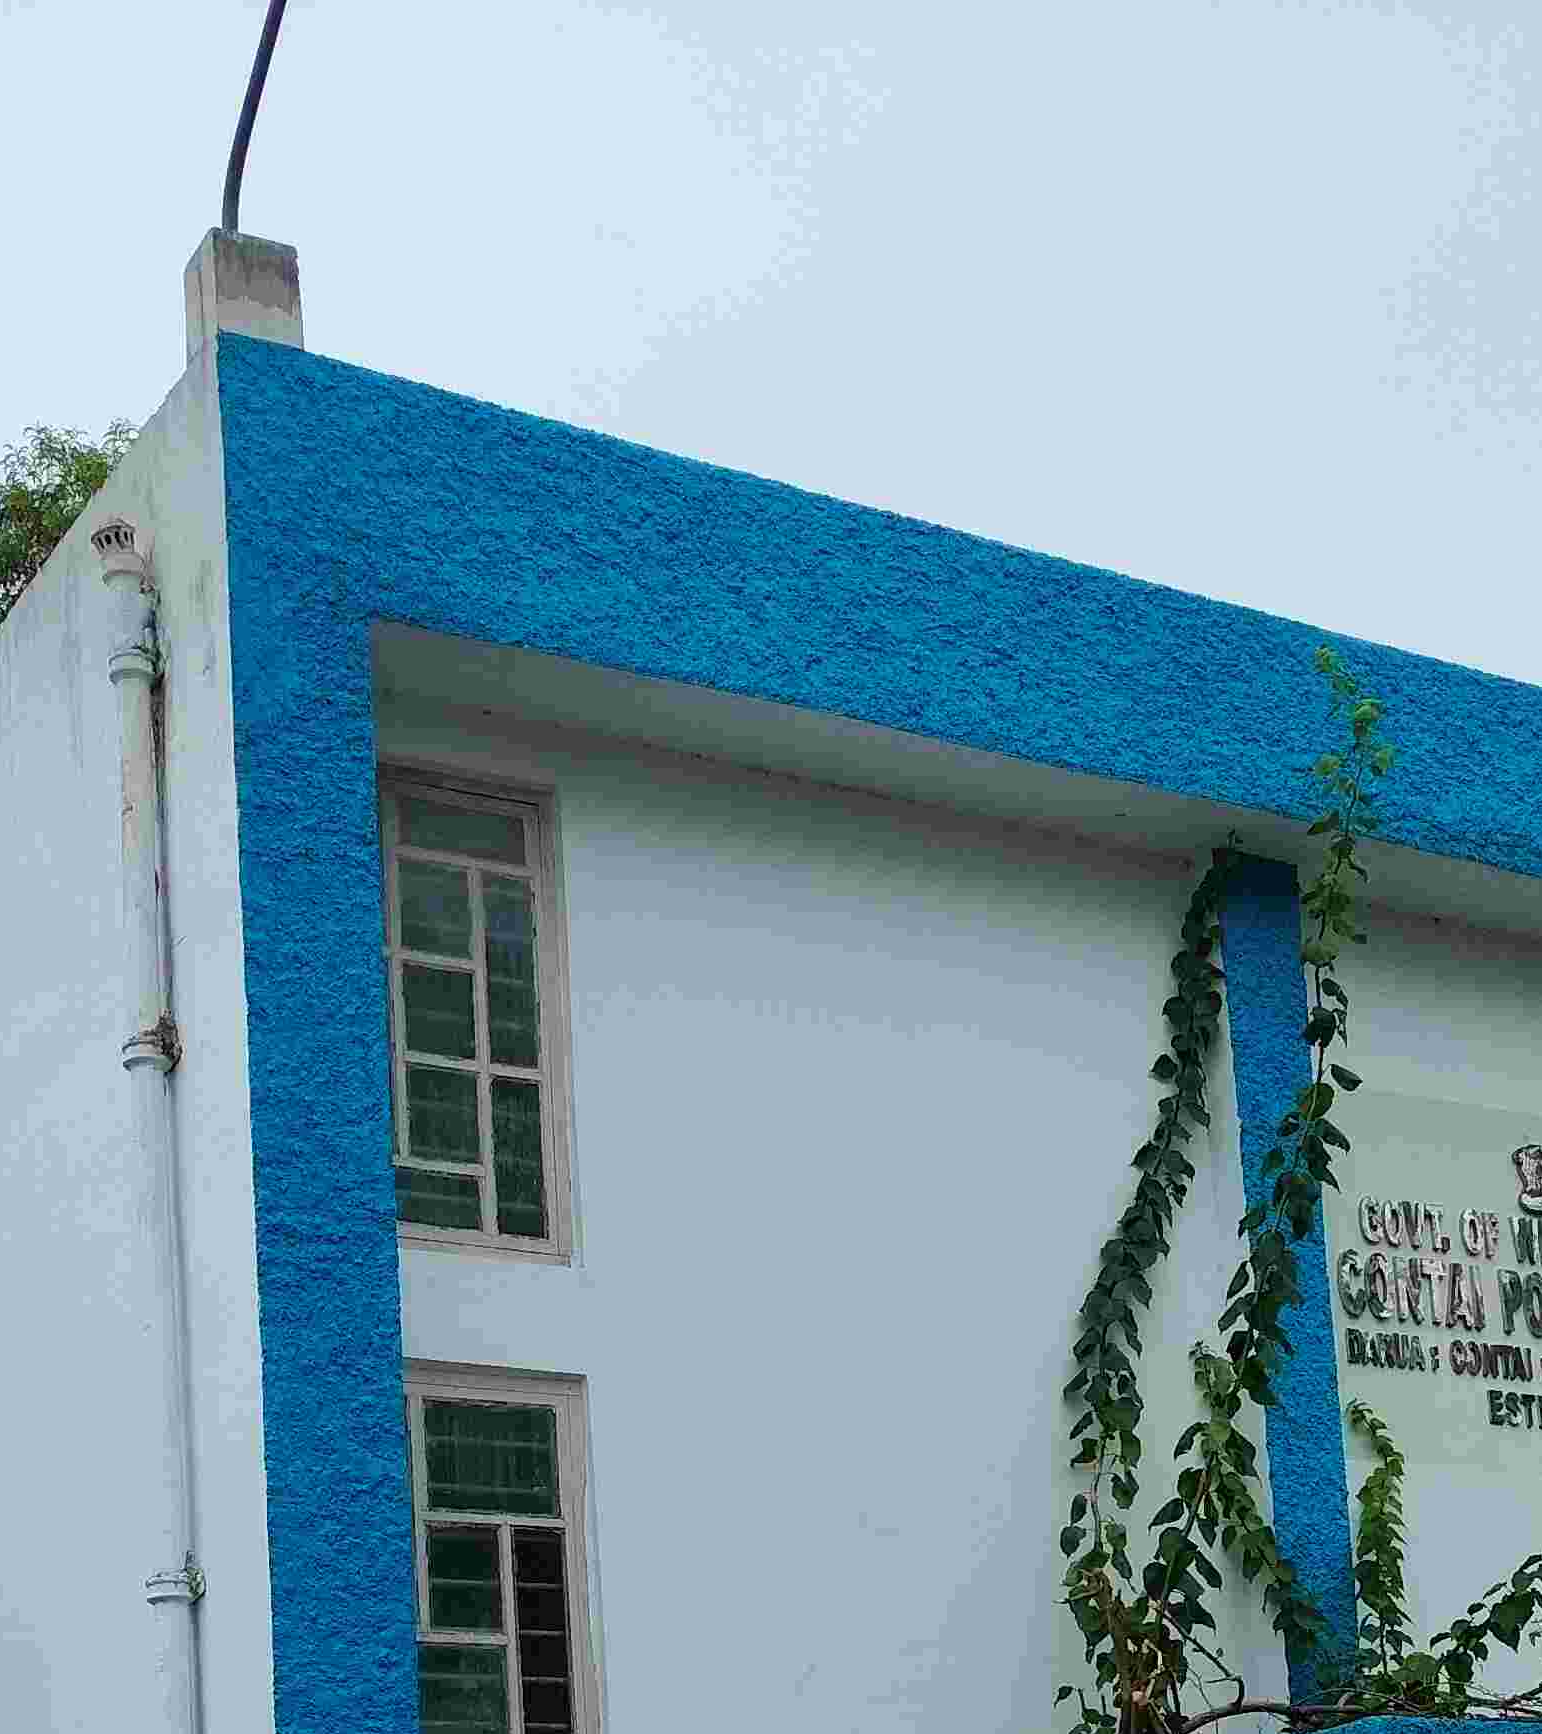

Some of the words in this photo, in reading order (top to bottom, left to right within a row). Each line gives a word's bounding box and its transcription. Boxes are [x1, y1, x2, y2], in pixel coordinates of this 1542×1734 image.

[1459, 1208, 1499, 1260] OF
[1338, 1249, 1486, 1332] CONTAI
[1451, 1339, 1533, 1381] CONTAI
